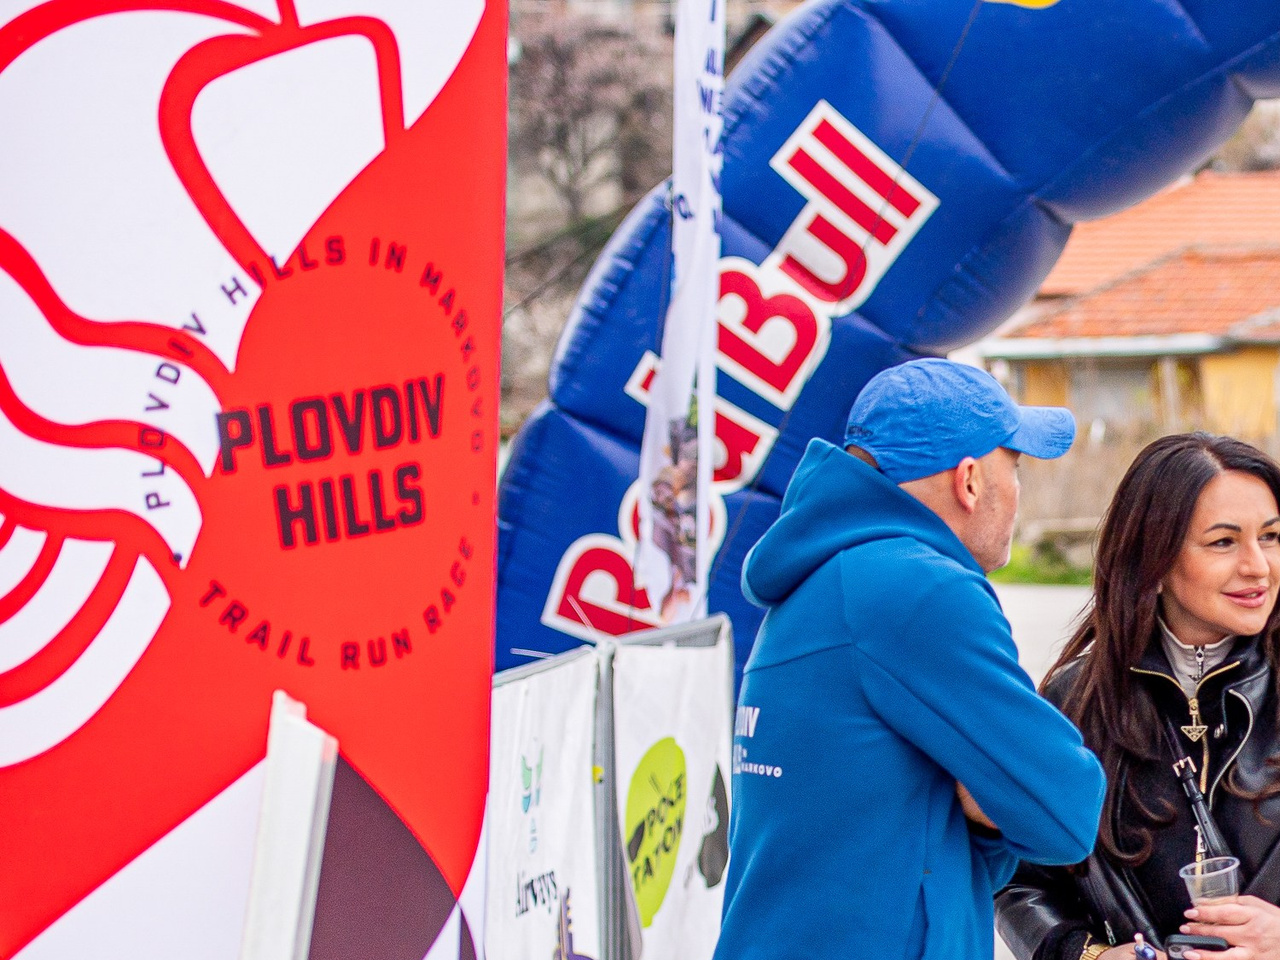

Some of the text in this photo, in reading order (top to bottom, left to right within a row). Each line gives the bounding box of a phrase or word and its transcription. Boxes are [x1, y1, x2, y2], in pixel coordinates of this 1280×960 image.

[138, 236, 485, 510] PLOVDIV HILLS IN MARKOVO
[216, 372, 446, 476] PLOVDIV
[273, 462, 425, 550] HILLS
[199, 536, 475, 671] TRAIL RUN RACE
